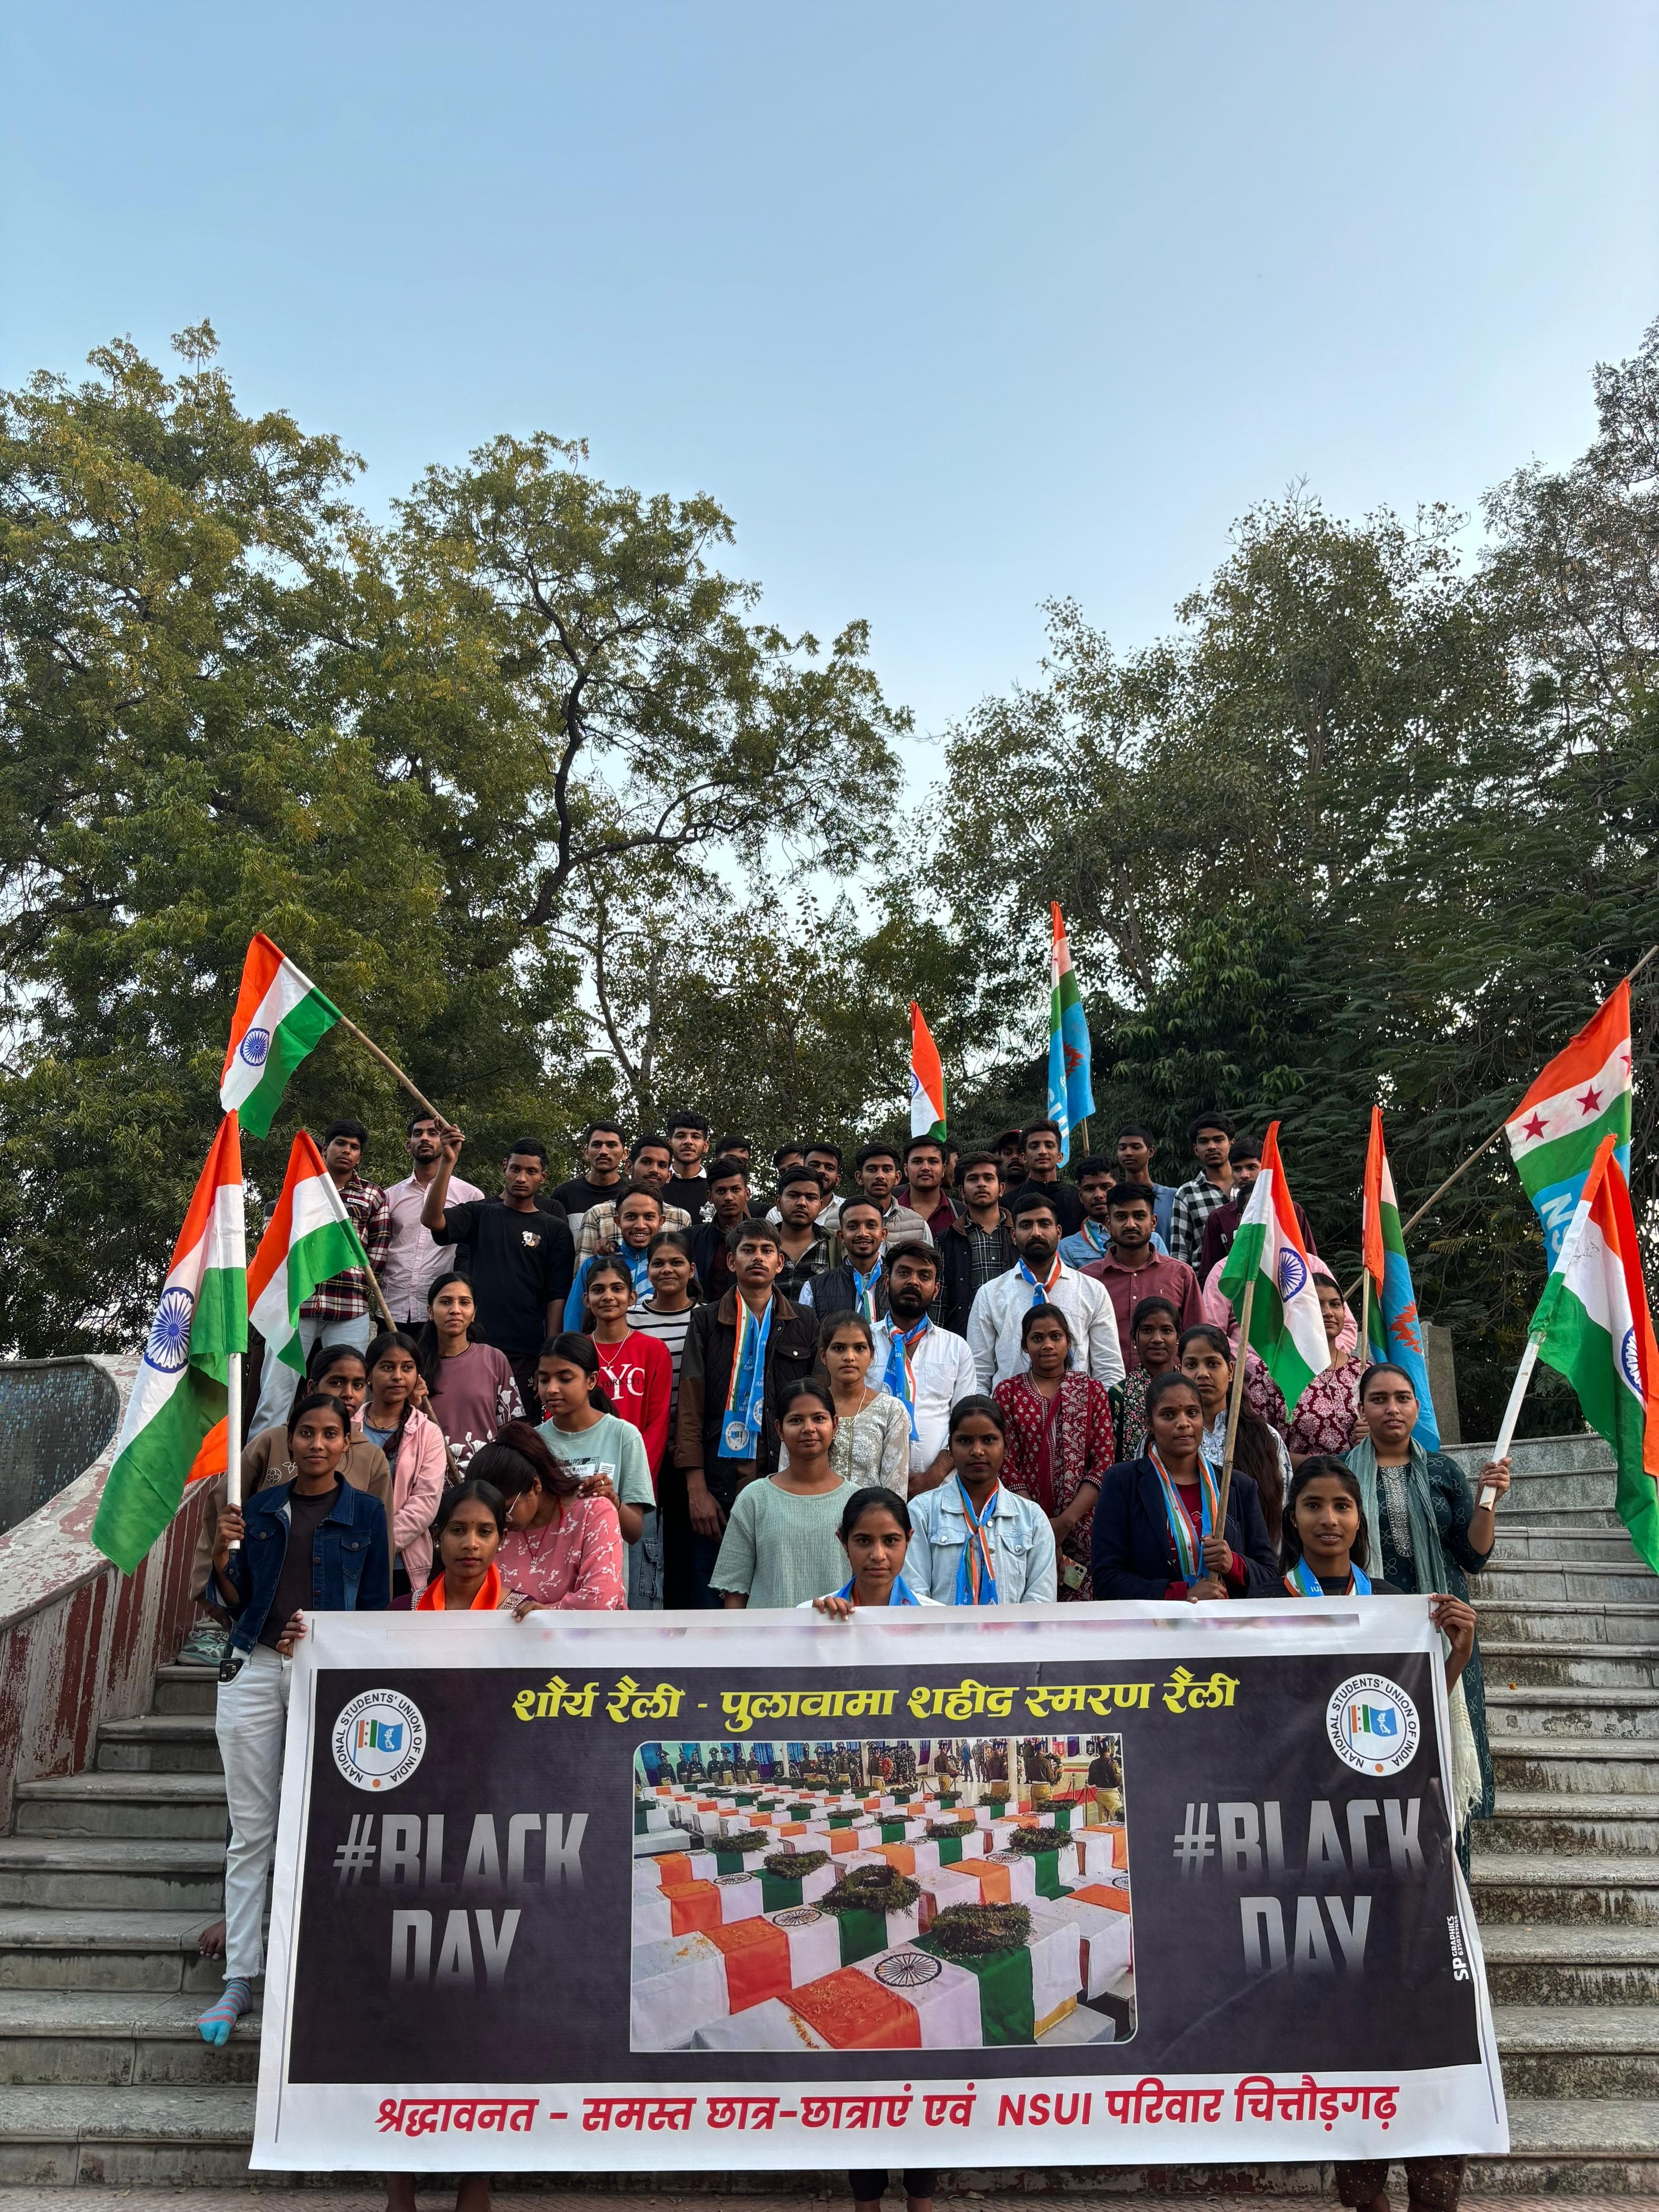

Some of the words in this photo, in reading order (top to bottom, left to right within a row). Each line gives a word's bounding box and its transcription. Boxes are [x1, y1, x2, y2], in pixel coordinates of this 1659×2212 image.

[599, 1363, 646, 1400] YC
[341, 1692, 397, 1726] STUDENTS'
[512, 1674, 599, 1722] शौर्य
[605, 1674, 685, 1723] रैली
[720, 1689, 899, 1733] पुलावामा
[907, 1679, 1019, 1721] शहीद
[1025, 1683, 1155, 1717] स्मरण
[1162, 1665, 1241, 1714] रैली
[1332, 1678, 1383, 1711] STUDENTS'
[1385, 1683, 1414, 1717] UNION
[398, 1699, 422, 1733] UNION
[1408, 1721, 1417, 1738] OF
[336, 1729, 364, 1783] NATIONAL
[414, 1737, 422, 1754] OF
[1330, 1714, 1364, 1768] NATIONAL
[1391, 1740, 1415, 1766] INDIA
[390, 1756, 416, 1782] INDIA
[333, 1813, 589, 1889] #BLACK
[1173, 1798, 1428, 1878] #BLACK
[390, 1908, 522, 1988] DAY
[1239, 1896, 1372, 1976] DAY
[1446, 1915, 1458, 1957] GRAPHICS
[1452, 1957, 1469, 1981] SP
[374, 2098, 541, 2138] श्रद्धावनत
[582, 2097, 698, 2132] समस्त
[923, 2082, 978, 2127] एवं
[998, 2093, 1092, 2127] NSUI
[1105, 2077, 1225, 2125] परिवार
[1234, 2074, 1401, 2132] चित्तौड़गढ़
